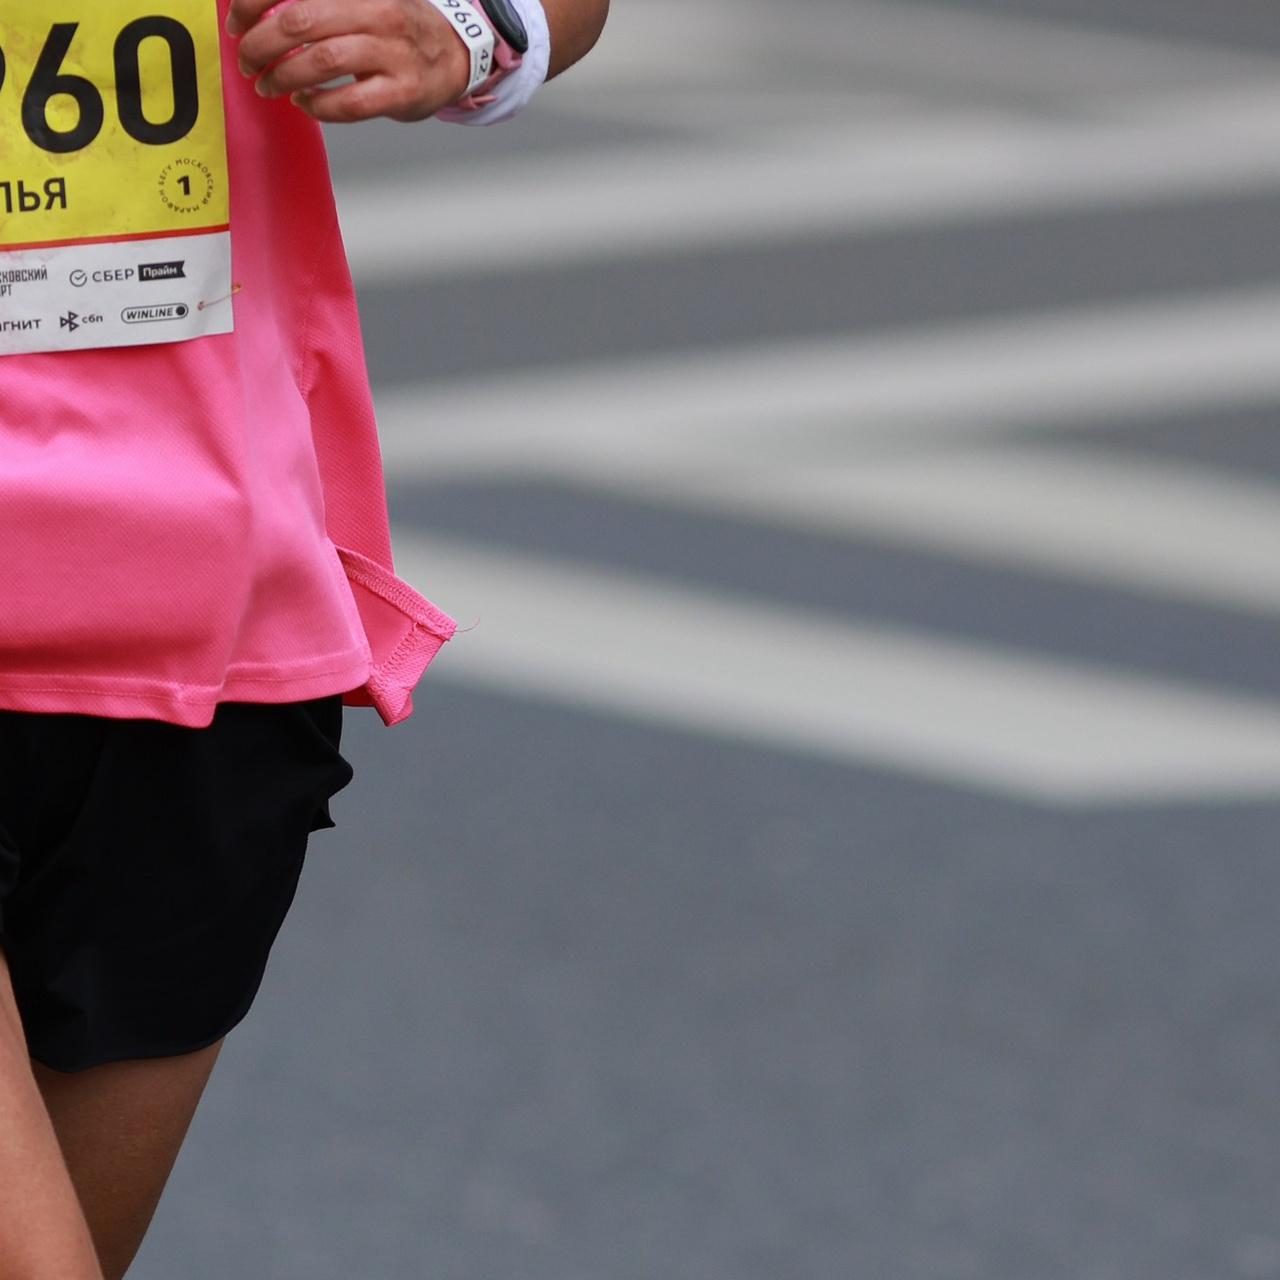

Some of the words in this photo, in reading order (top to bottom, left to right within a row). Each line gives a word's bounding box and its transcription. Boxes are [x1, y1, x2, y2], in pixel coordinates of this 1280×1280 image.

[177, 174, 190, 196] 1
[92, 268, 135, 283] СБЕР
[142, 265, 178, 278] Прайм
[81, 314, 104, 324] сбп
[126, 307, 174, 321] WINLINE
